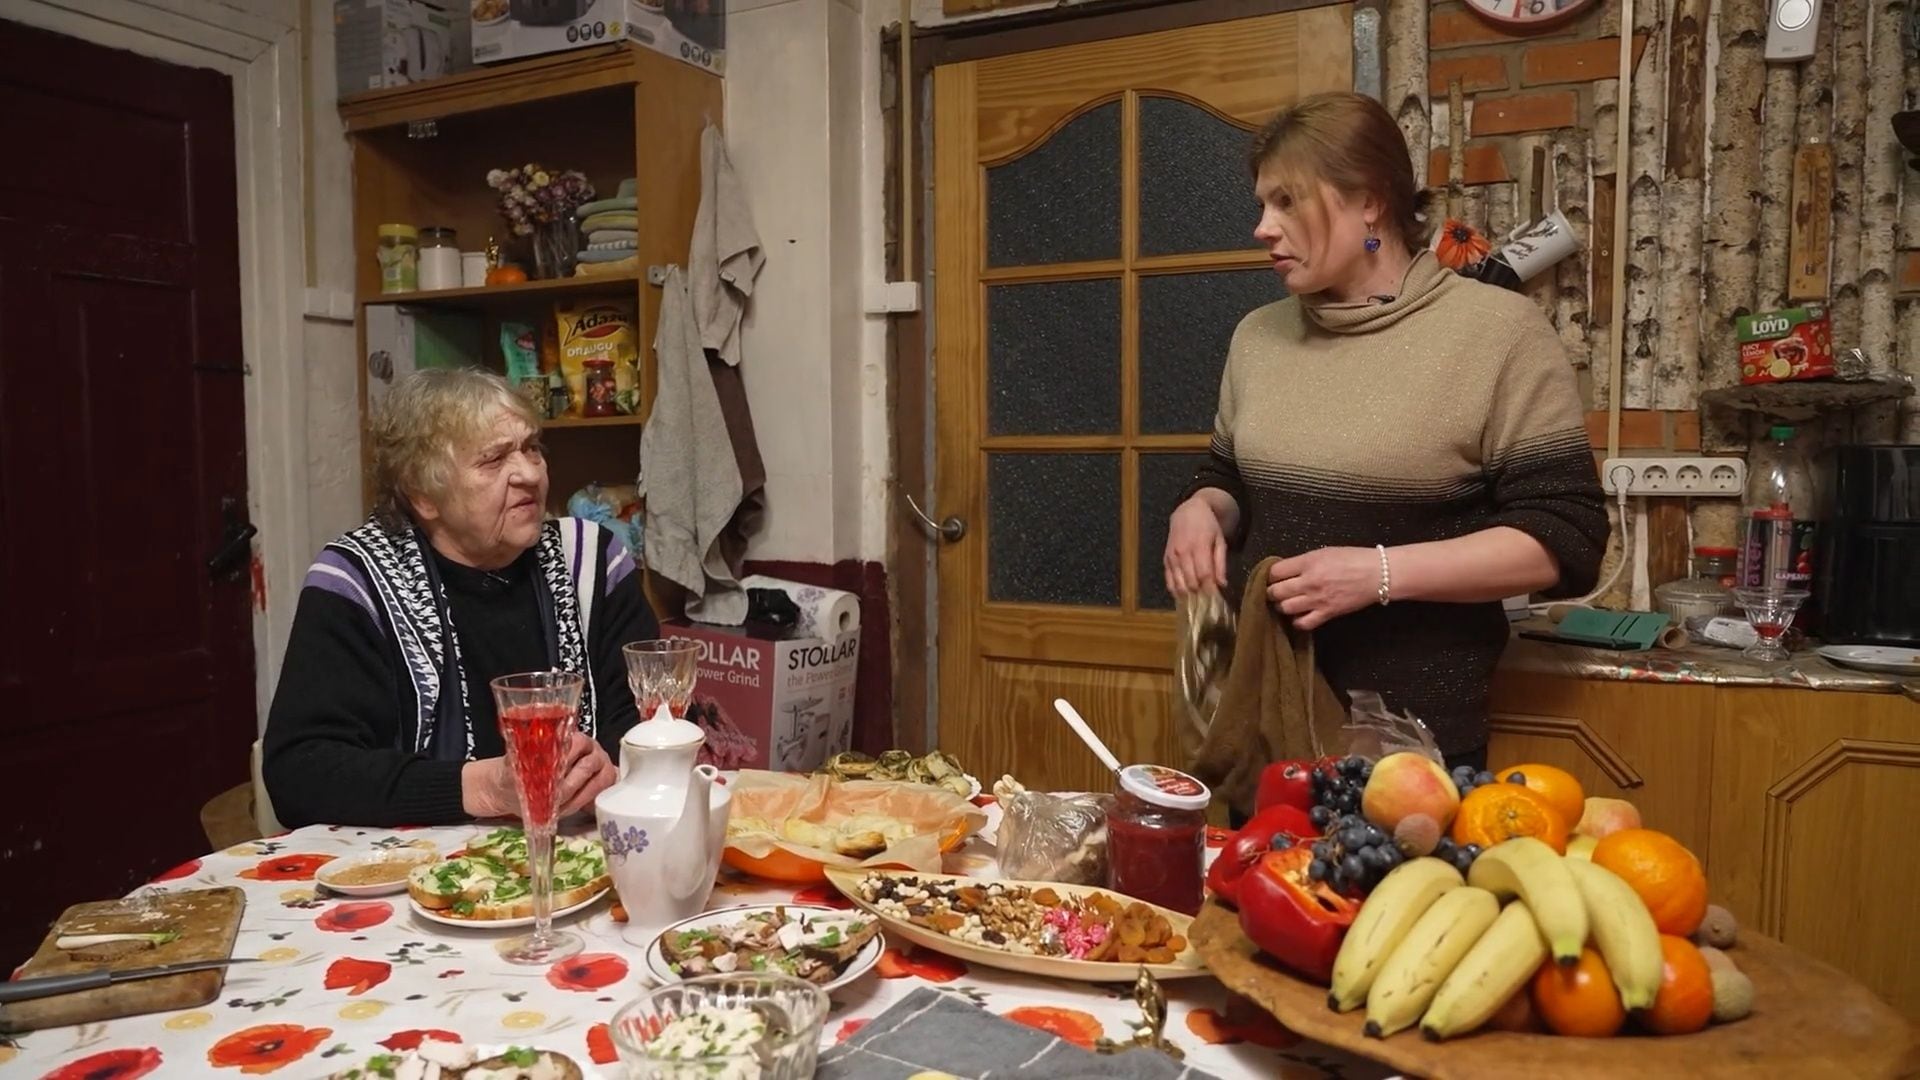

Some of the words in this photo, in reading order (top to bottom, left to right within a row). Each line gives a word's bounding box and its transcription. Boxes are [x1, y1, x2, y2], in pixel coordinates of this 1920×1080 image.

[1751, 318, 1789, 335] LOYD
[567, 342, 613, 357] DRAUGU
[669, 635, 760, 670] OLLAR
[788, 639, 856, 670] STOLLAR
[727, 670, 760, 688] Grind
